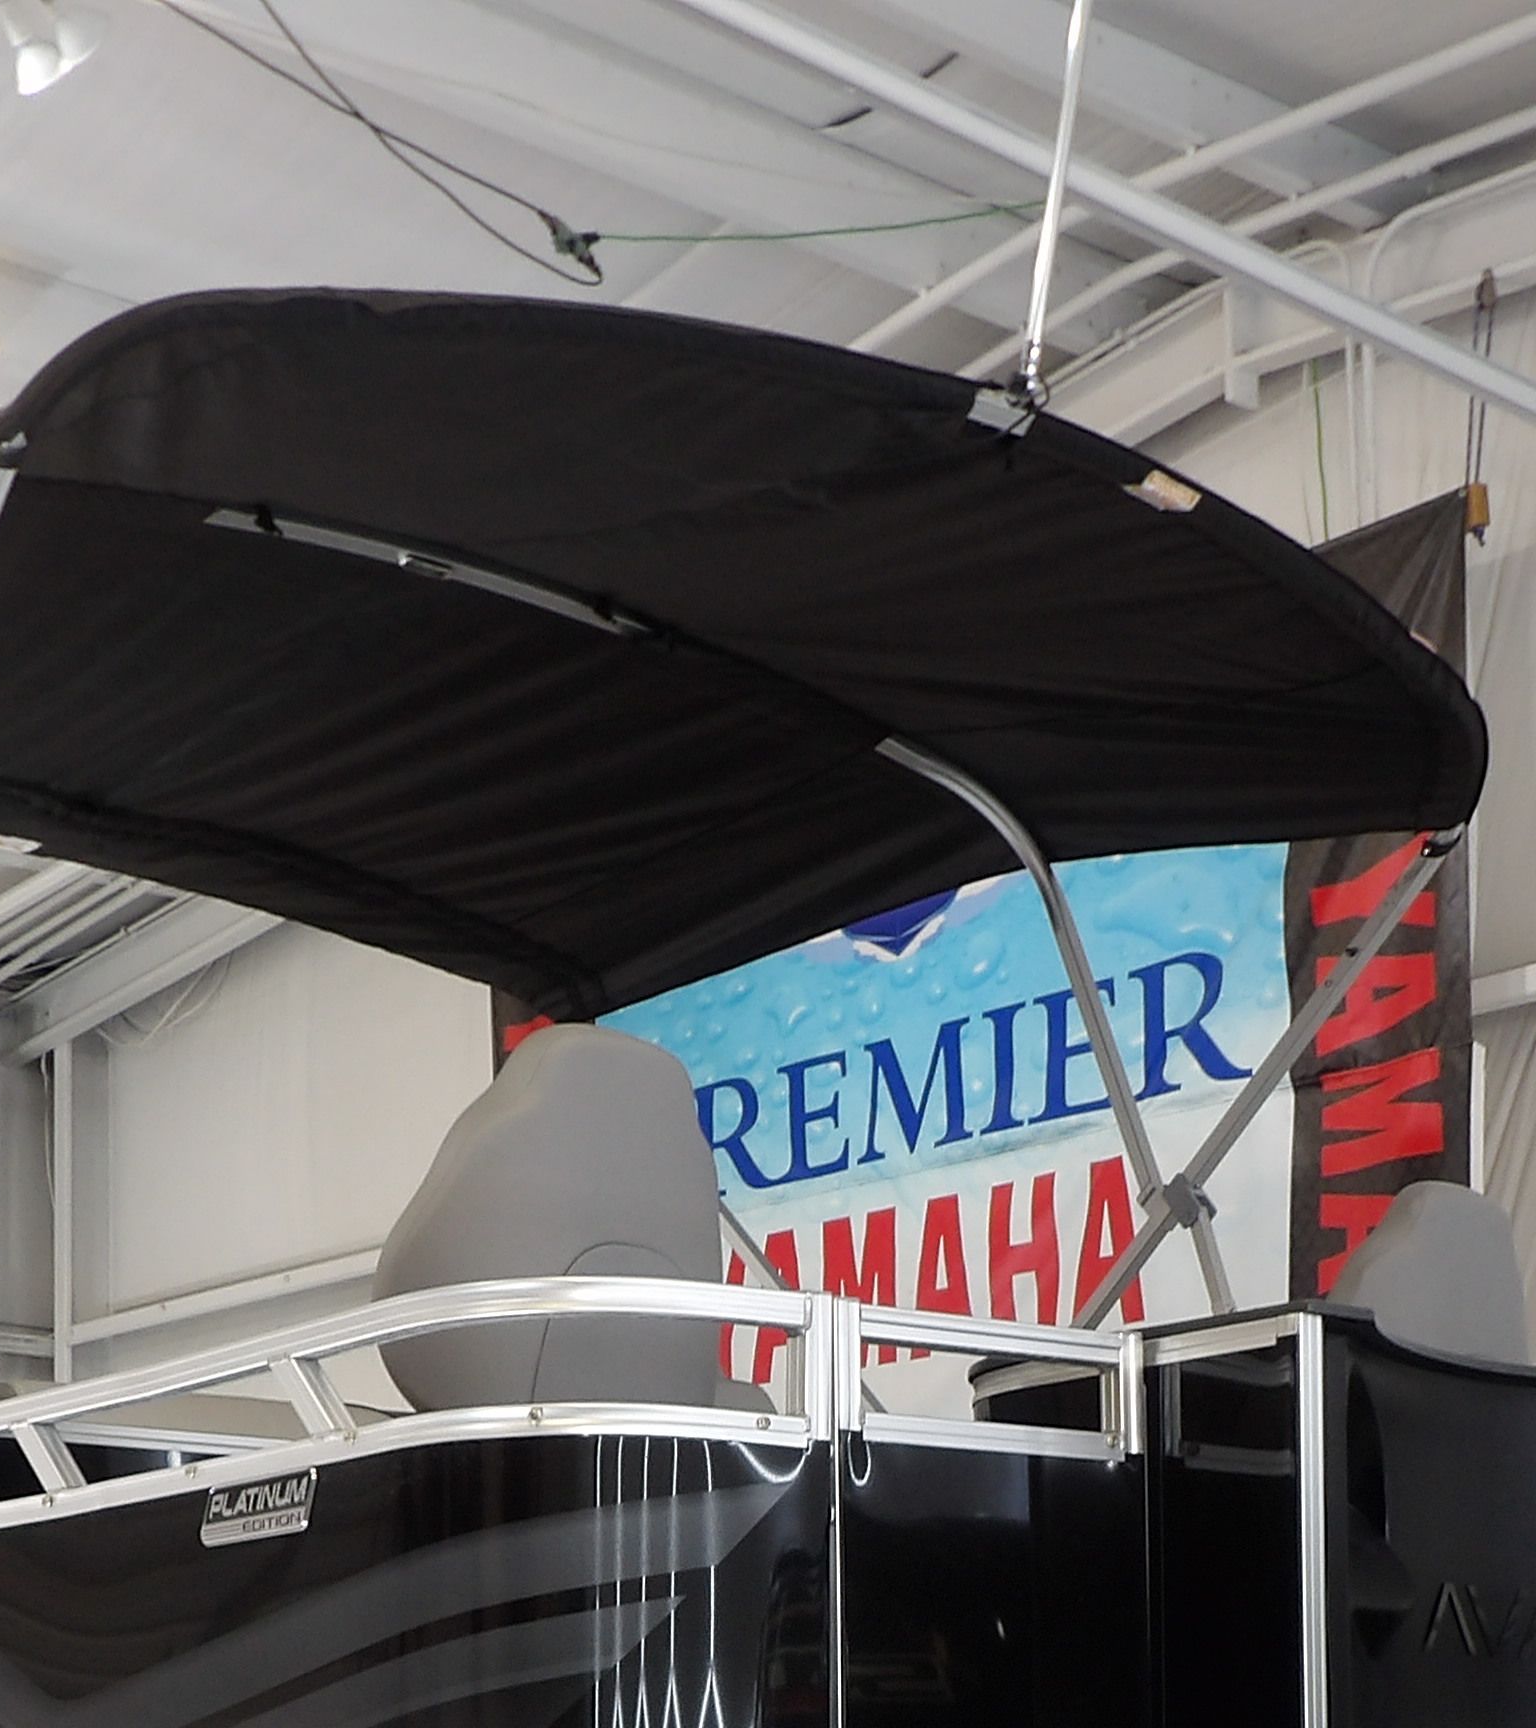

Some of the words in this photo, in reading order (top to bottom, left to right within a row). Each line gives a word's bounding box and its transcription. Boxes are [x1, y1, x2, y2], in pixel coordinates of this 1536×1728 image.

[694, 952, 1253, 1197] REMIER
[719, 1155, 1145, 1385] AMAHA
[208, 1475, 310, 1520] PLATINUM
[242, 1510, 304, 1533] EDITION
